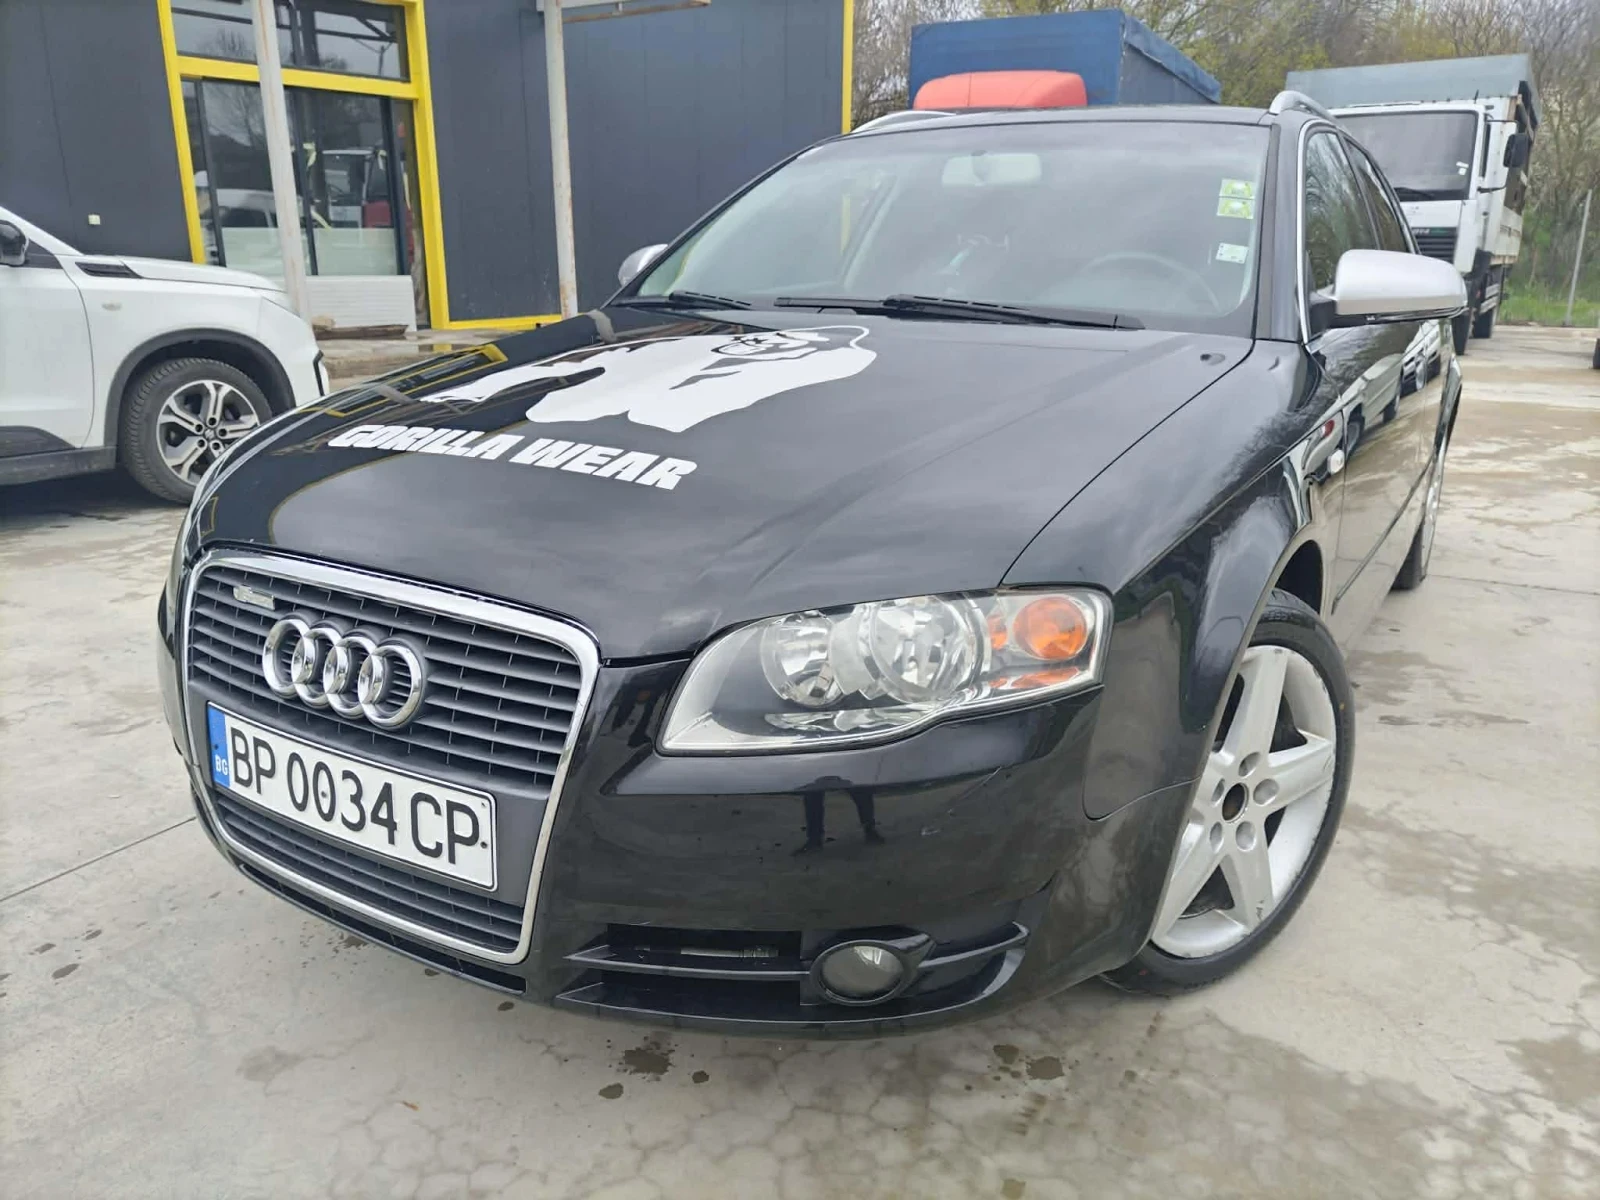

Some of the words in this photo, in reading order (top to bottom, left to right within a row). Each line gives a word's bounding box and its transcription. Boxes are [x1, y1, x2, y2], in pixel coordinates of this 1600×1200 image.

[328, 425, 525, 460] GORILLA
[509, 438, 698, 490] WEAR
[214, 755, 229, 776] BG
[231, 727, 276, 794] BP
[287, 752, 398, 846] 0034
[411, 792, 479, 864] CP
